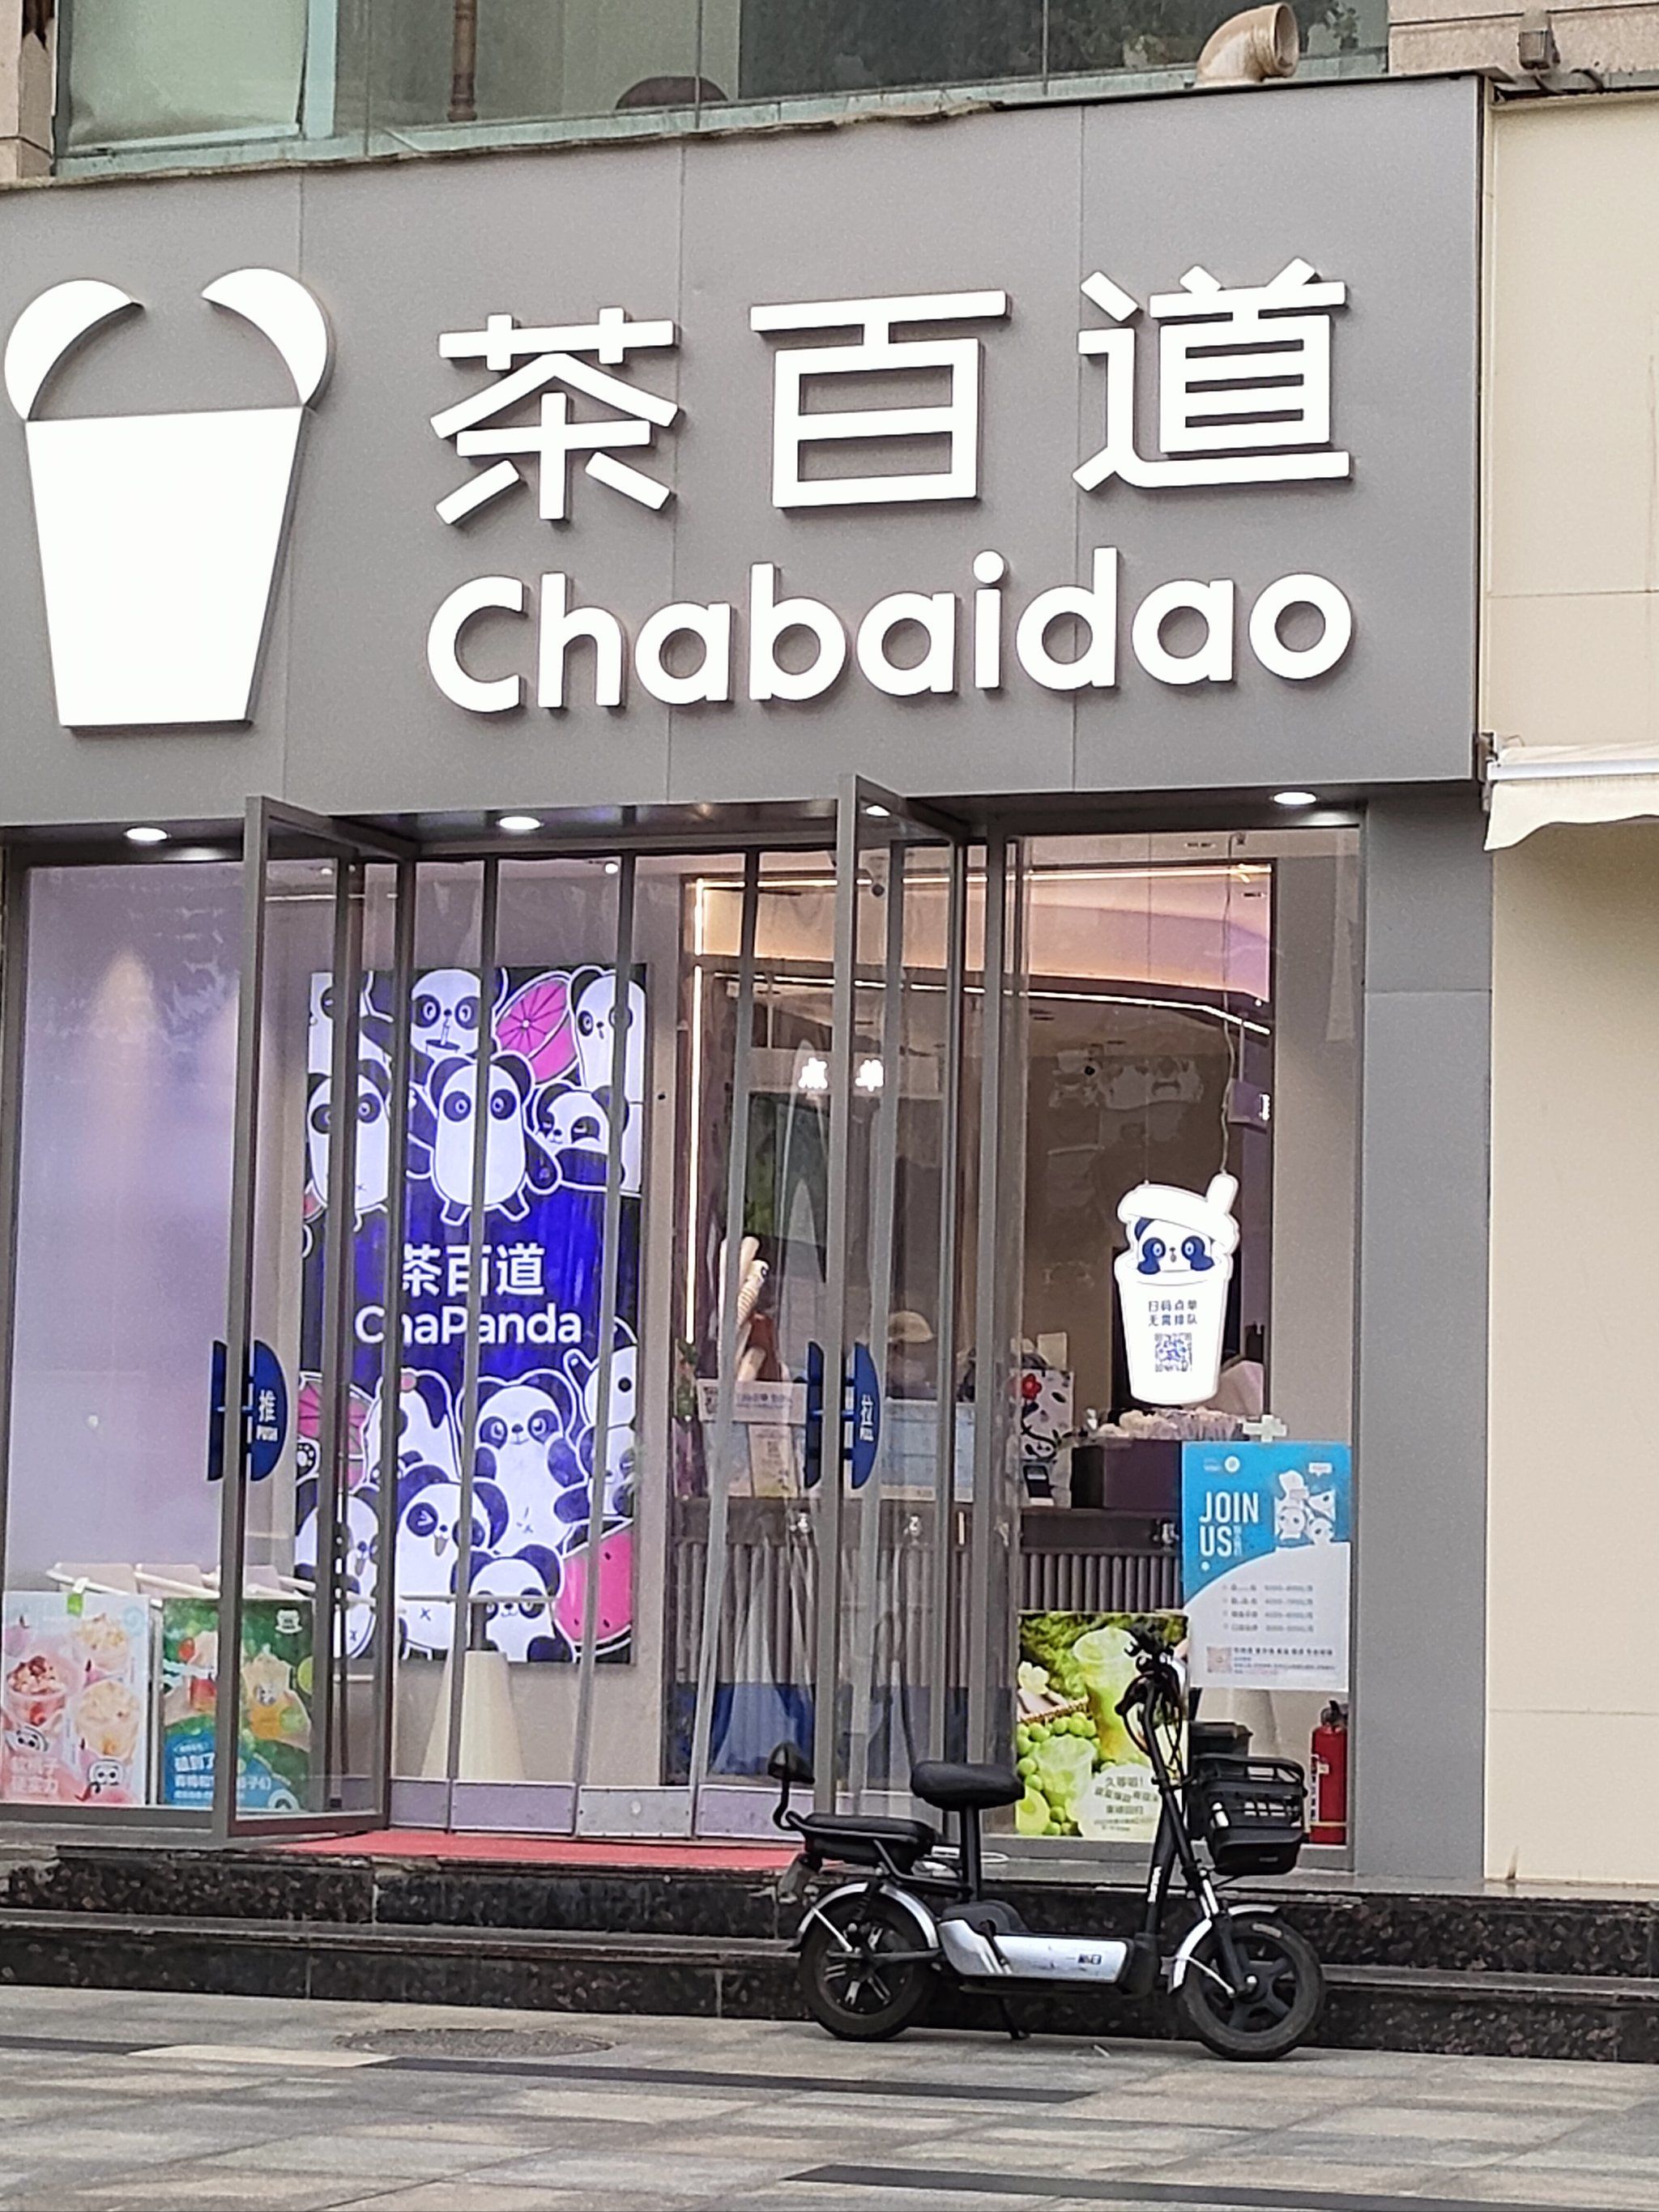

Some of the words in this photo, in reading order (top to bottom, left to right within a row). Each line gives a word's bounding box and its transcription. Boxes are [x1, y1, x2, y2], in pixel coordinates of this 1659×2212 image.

[430, 258, 1350, 525] 茶百道
[427, 547, 1352, 713] Chabaidao
[402, 1242, 545, 1297] 茶百道
[258, 1389, 276, 1422] 推
[1199, 1491, 1259, 1524] JOIN
[1199, 1525, 1232, 1558] US
